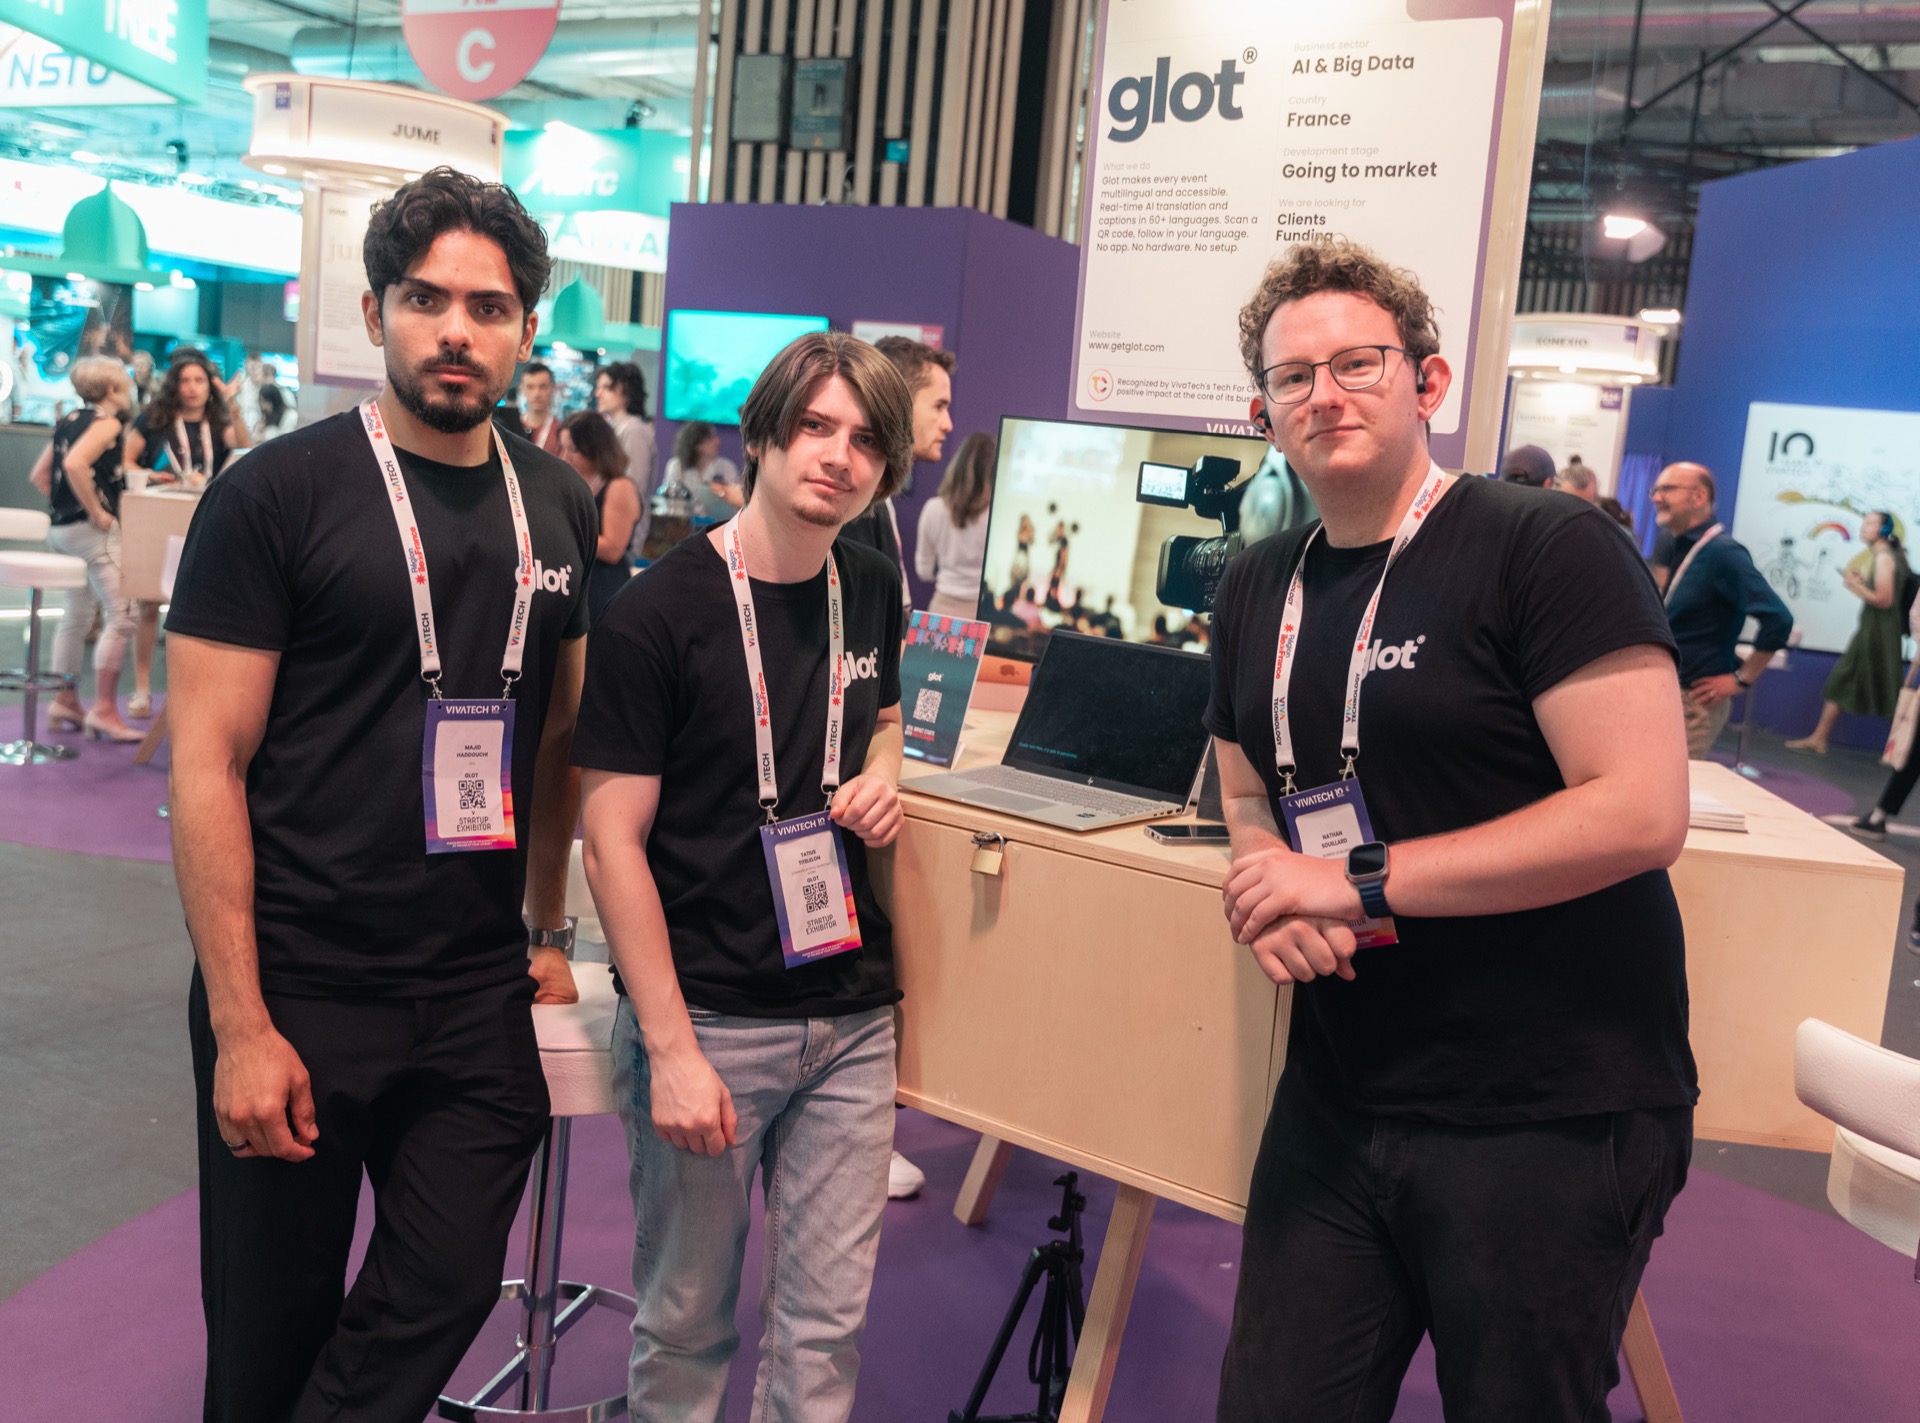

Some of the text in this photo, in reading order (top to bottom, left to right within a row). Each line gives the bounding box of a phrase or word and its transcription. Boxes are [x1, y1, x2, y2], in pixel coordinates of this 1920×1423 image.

[1338, 40, 1370, 49] sector
[456, 28, 497, 83] C
[1292, 54, 1414, 77] AI & Big Data
[1288, 95, 1327, 106] Country
[1287, 112, 1351, 127] France
[391, 123, 442, 145] JUME
[1283, 146, 1379, 158] Development stage
[1103, 163, 1125, 171] What
[1139, 162, 1150, 170] do
[1282, 161, 1437, 183] Going to market
[1102, 174, 1208, 186] Glot makes every event
[1101, 187, 1228, 200] multilingual and accessible.
[1099, 201, 1228, 212] Real-time AI translation and
[1278, 198, 1366, 210] We are looking for
[1098, 216, 1137, 227] captions
[1138, 215, 1147, 225] in
[1168, 215, 1222, 227] languages.
[1224, 215, 1249, 224] Scan
[1250, 216, 1258, 224] a
[1277, 212, 1326, 225] Clients
[1097, 229, 1110, 239] QR
[1137, 228, 1164, 239] follow
[1166, 229, 1174, 238] in
[1176, 230, 1198, 241] your
[1200, 228, 1249, 241] language.
[1096, 242, 1240, 254] No app. No hardware. No setup.
[1089, 330, 1121, 339] Website
[1088, 342, 1165, 353] www.getglot.com
[1117, 378, 1158, 388] Recognized
[1159, 379, 1170, 389] by
[1171, 380, 1211, 390] VivaTech's
[1212, 382, 1231, 391] Tech
[1233, 383, 1246, 392] For
[1116, 388, 1251, 403] positive impact at the core of its bus
[1351, 672, 1361, 723] TECHNOLOGY
[445, 705, 490, 715] VIVATECH
[1273, 697, 1282, 746] TECHNOLOGY
[1294, 791, 1335, 809] VIVATECH
[459, 816, 489, 825] STARTUP
[456, 823, 492, 833] EXHIBITOR
[777, 819, 818, 837] VIVATECH
[805, 920, 838, 936] EXHIBITOR
[806, 914, 834, 929] STARTUP
